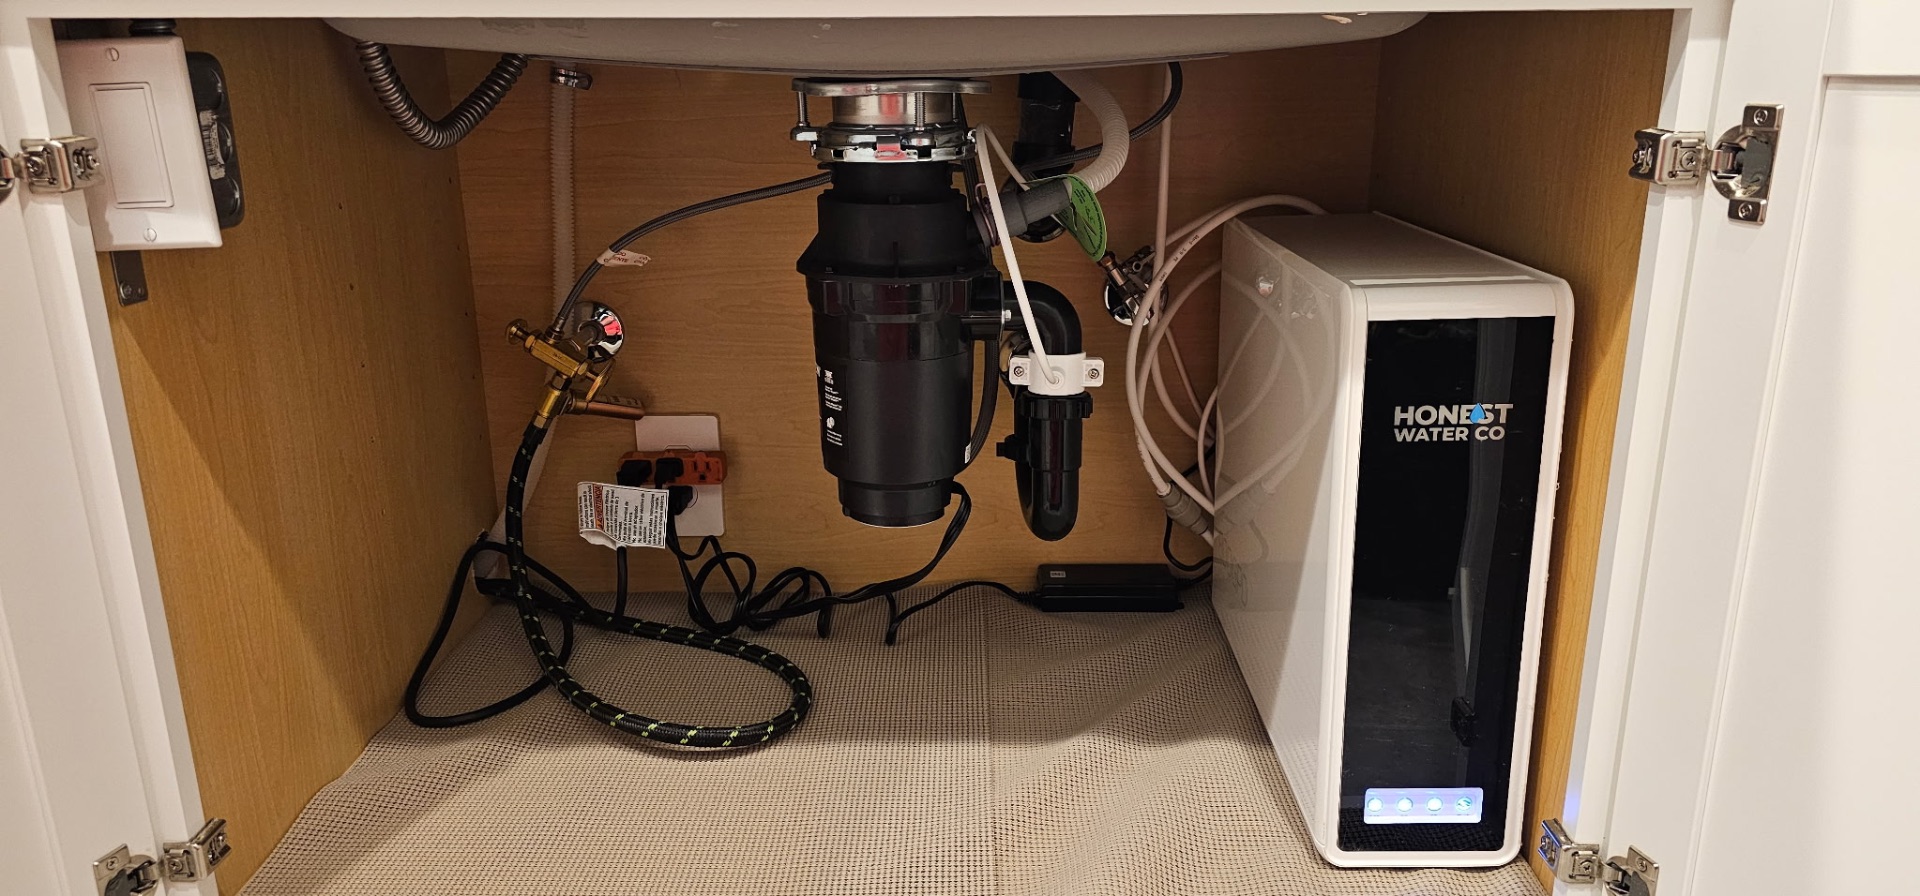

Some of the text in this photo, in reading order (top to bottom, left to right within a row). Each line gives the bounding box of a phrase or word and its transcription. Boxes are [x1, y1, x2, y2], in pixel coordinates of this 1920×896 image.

[1393, 403, 1514, 425] HONEST
[1393, 426, 1506, 442] WATER CO
